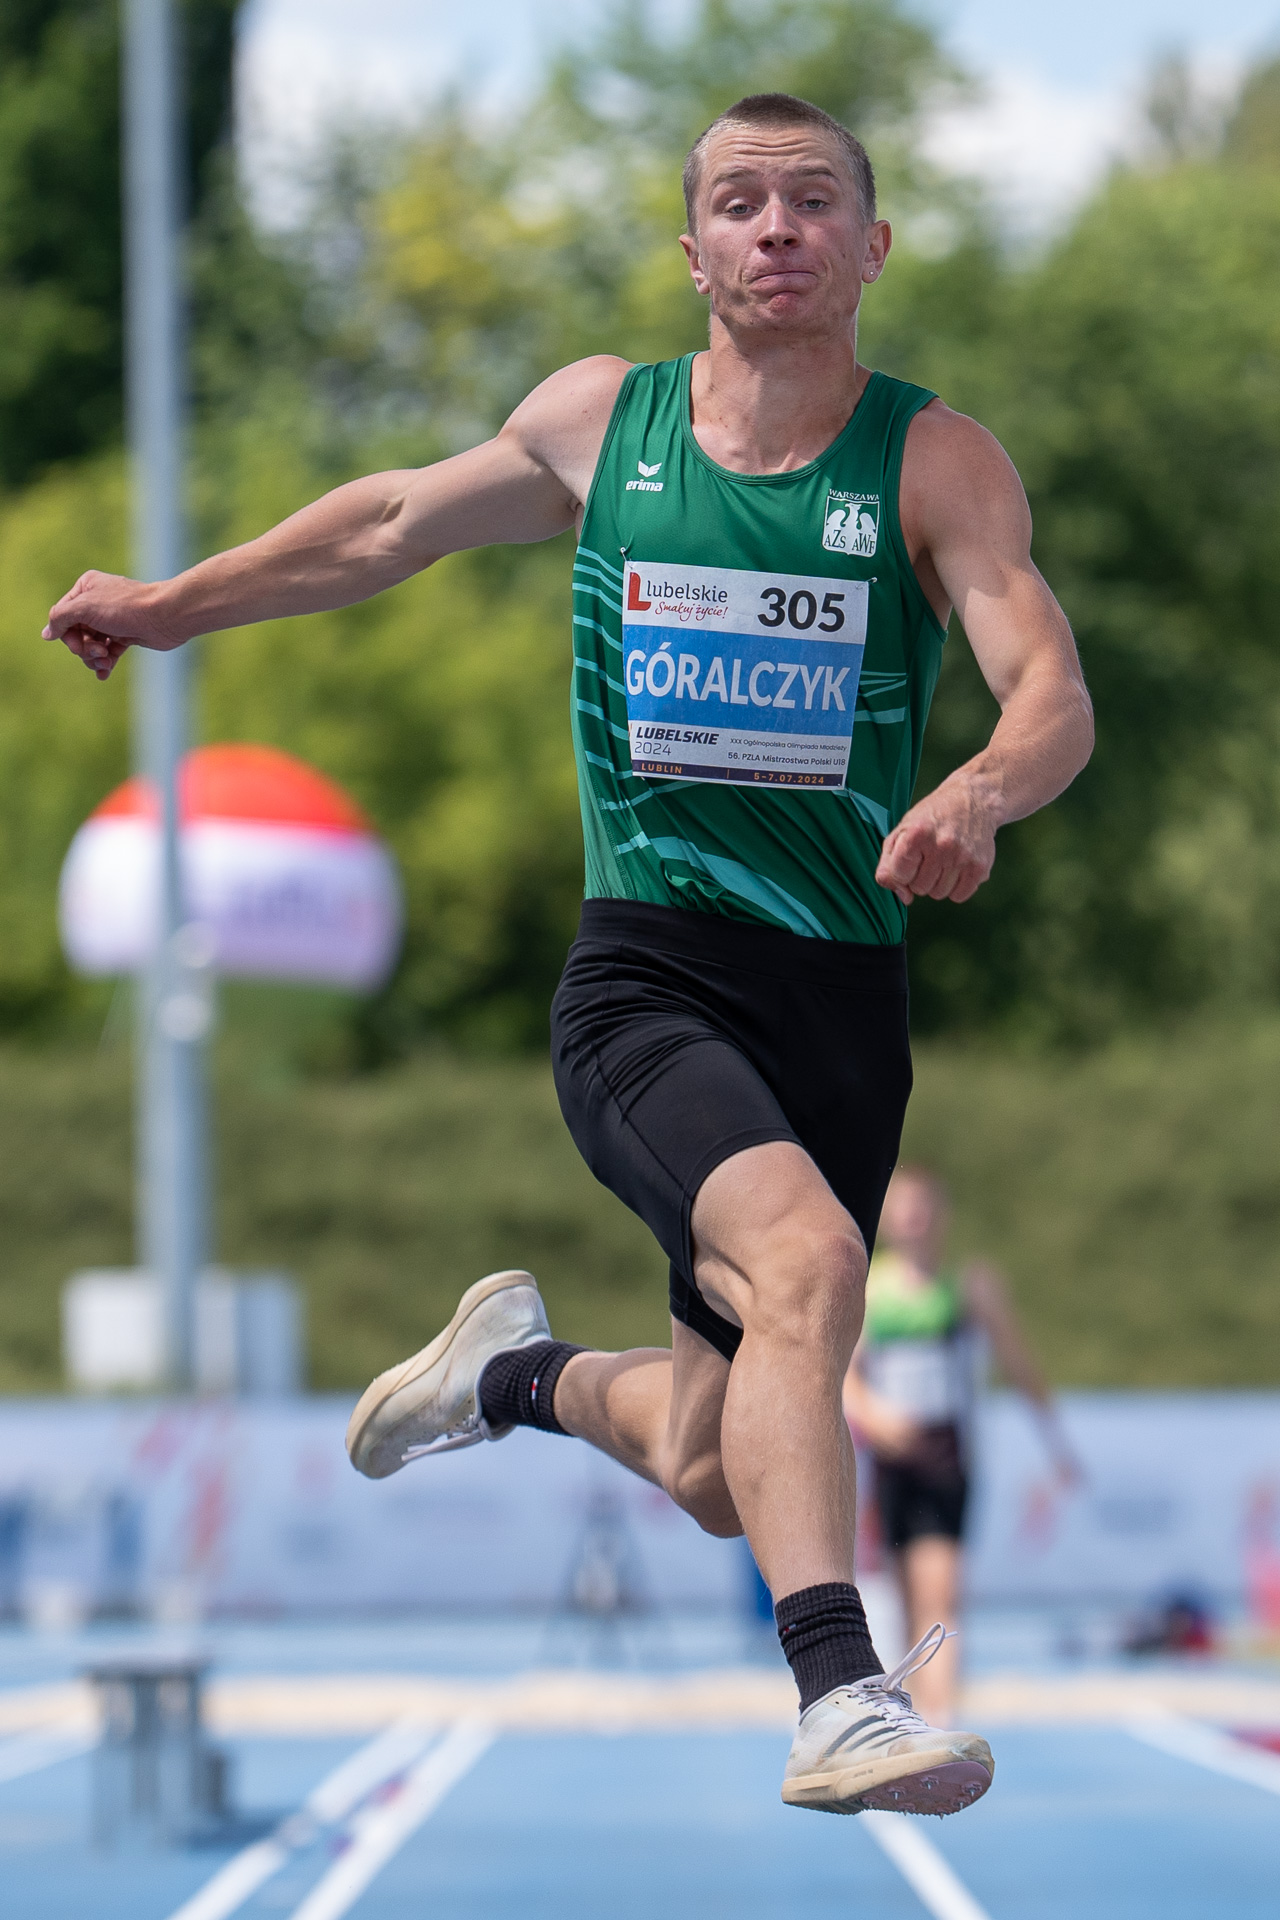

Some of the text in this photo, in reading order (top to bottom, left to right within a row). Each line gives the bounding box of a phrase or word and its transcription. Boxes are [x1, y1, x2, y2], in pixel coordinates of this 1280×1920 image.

[626, 479, 664, 492] erima
[829, 488, 880, 501] WARSZAWA
[824, 529, 875, 554] AZS AWF
[647, 580, 728, 603] lubelskie
[655, 601, 729, 622] Smakuj życie!
[757, 587, 845, 633] 305
[626, 642, 851, 711] GÓRALCZYK
[636, 726, 720, 745] LUBELSKIE
[634, 741, 671, 756] 2024
[743, 739, 786, 748] Ogólnopolska
[786, 742, 819, 750] Olimpiada
[728, 751, 846, 766] 56. PZLA Mistrzostwa Polski U18
[641, 762, 682, 774] LUBLIN
[753, 772, 825, 785] 5-7.07.2024
